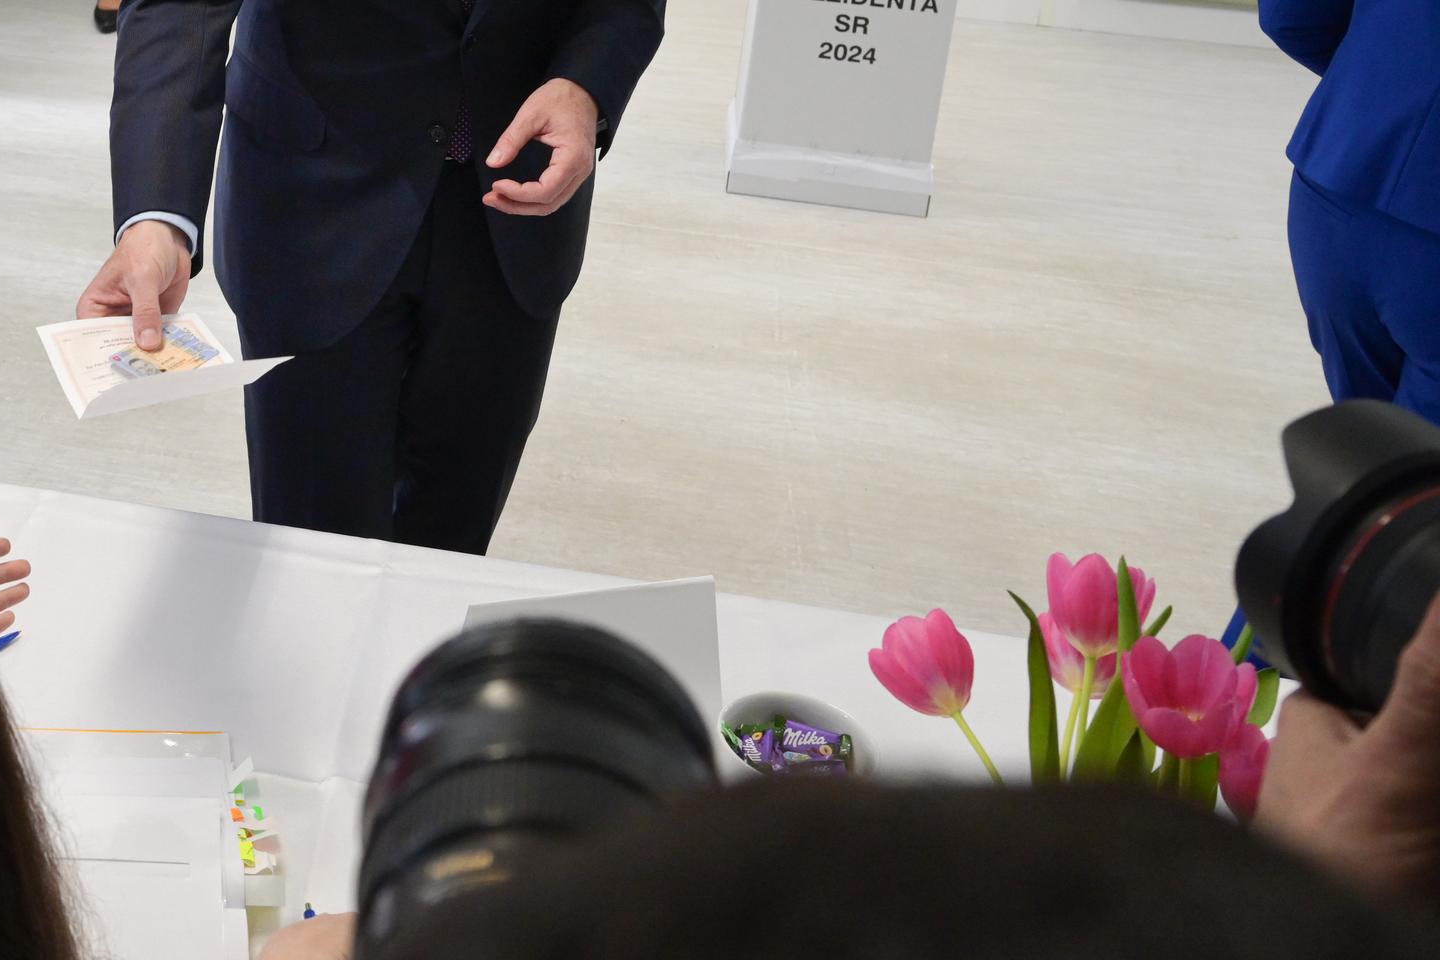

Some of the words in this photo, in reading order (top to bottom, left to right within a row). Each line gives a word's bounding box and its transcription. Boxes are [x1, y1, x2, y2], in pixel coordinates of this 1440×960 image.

[834, 13, 870, 35] SR
[818, 41, 877, 65] 2024
[783, 727, 828, 748] Milka
